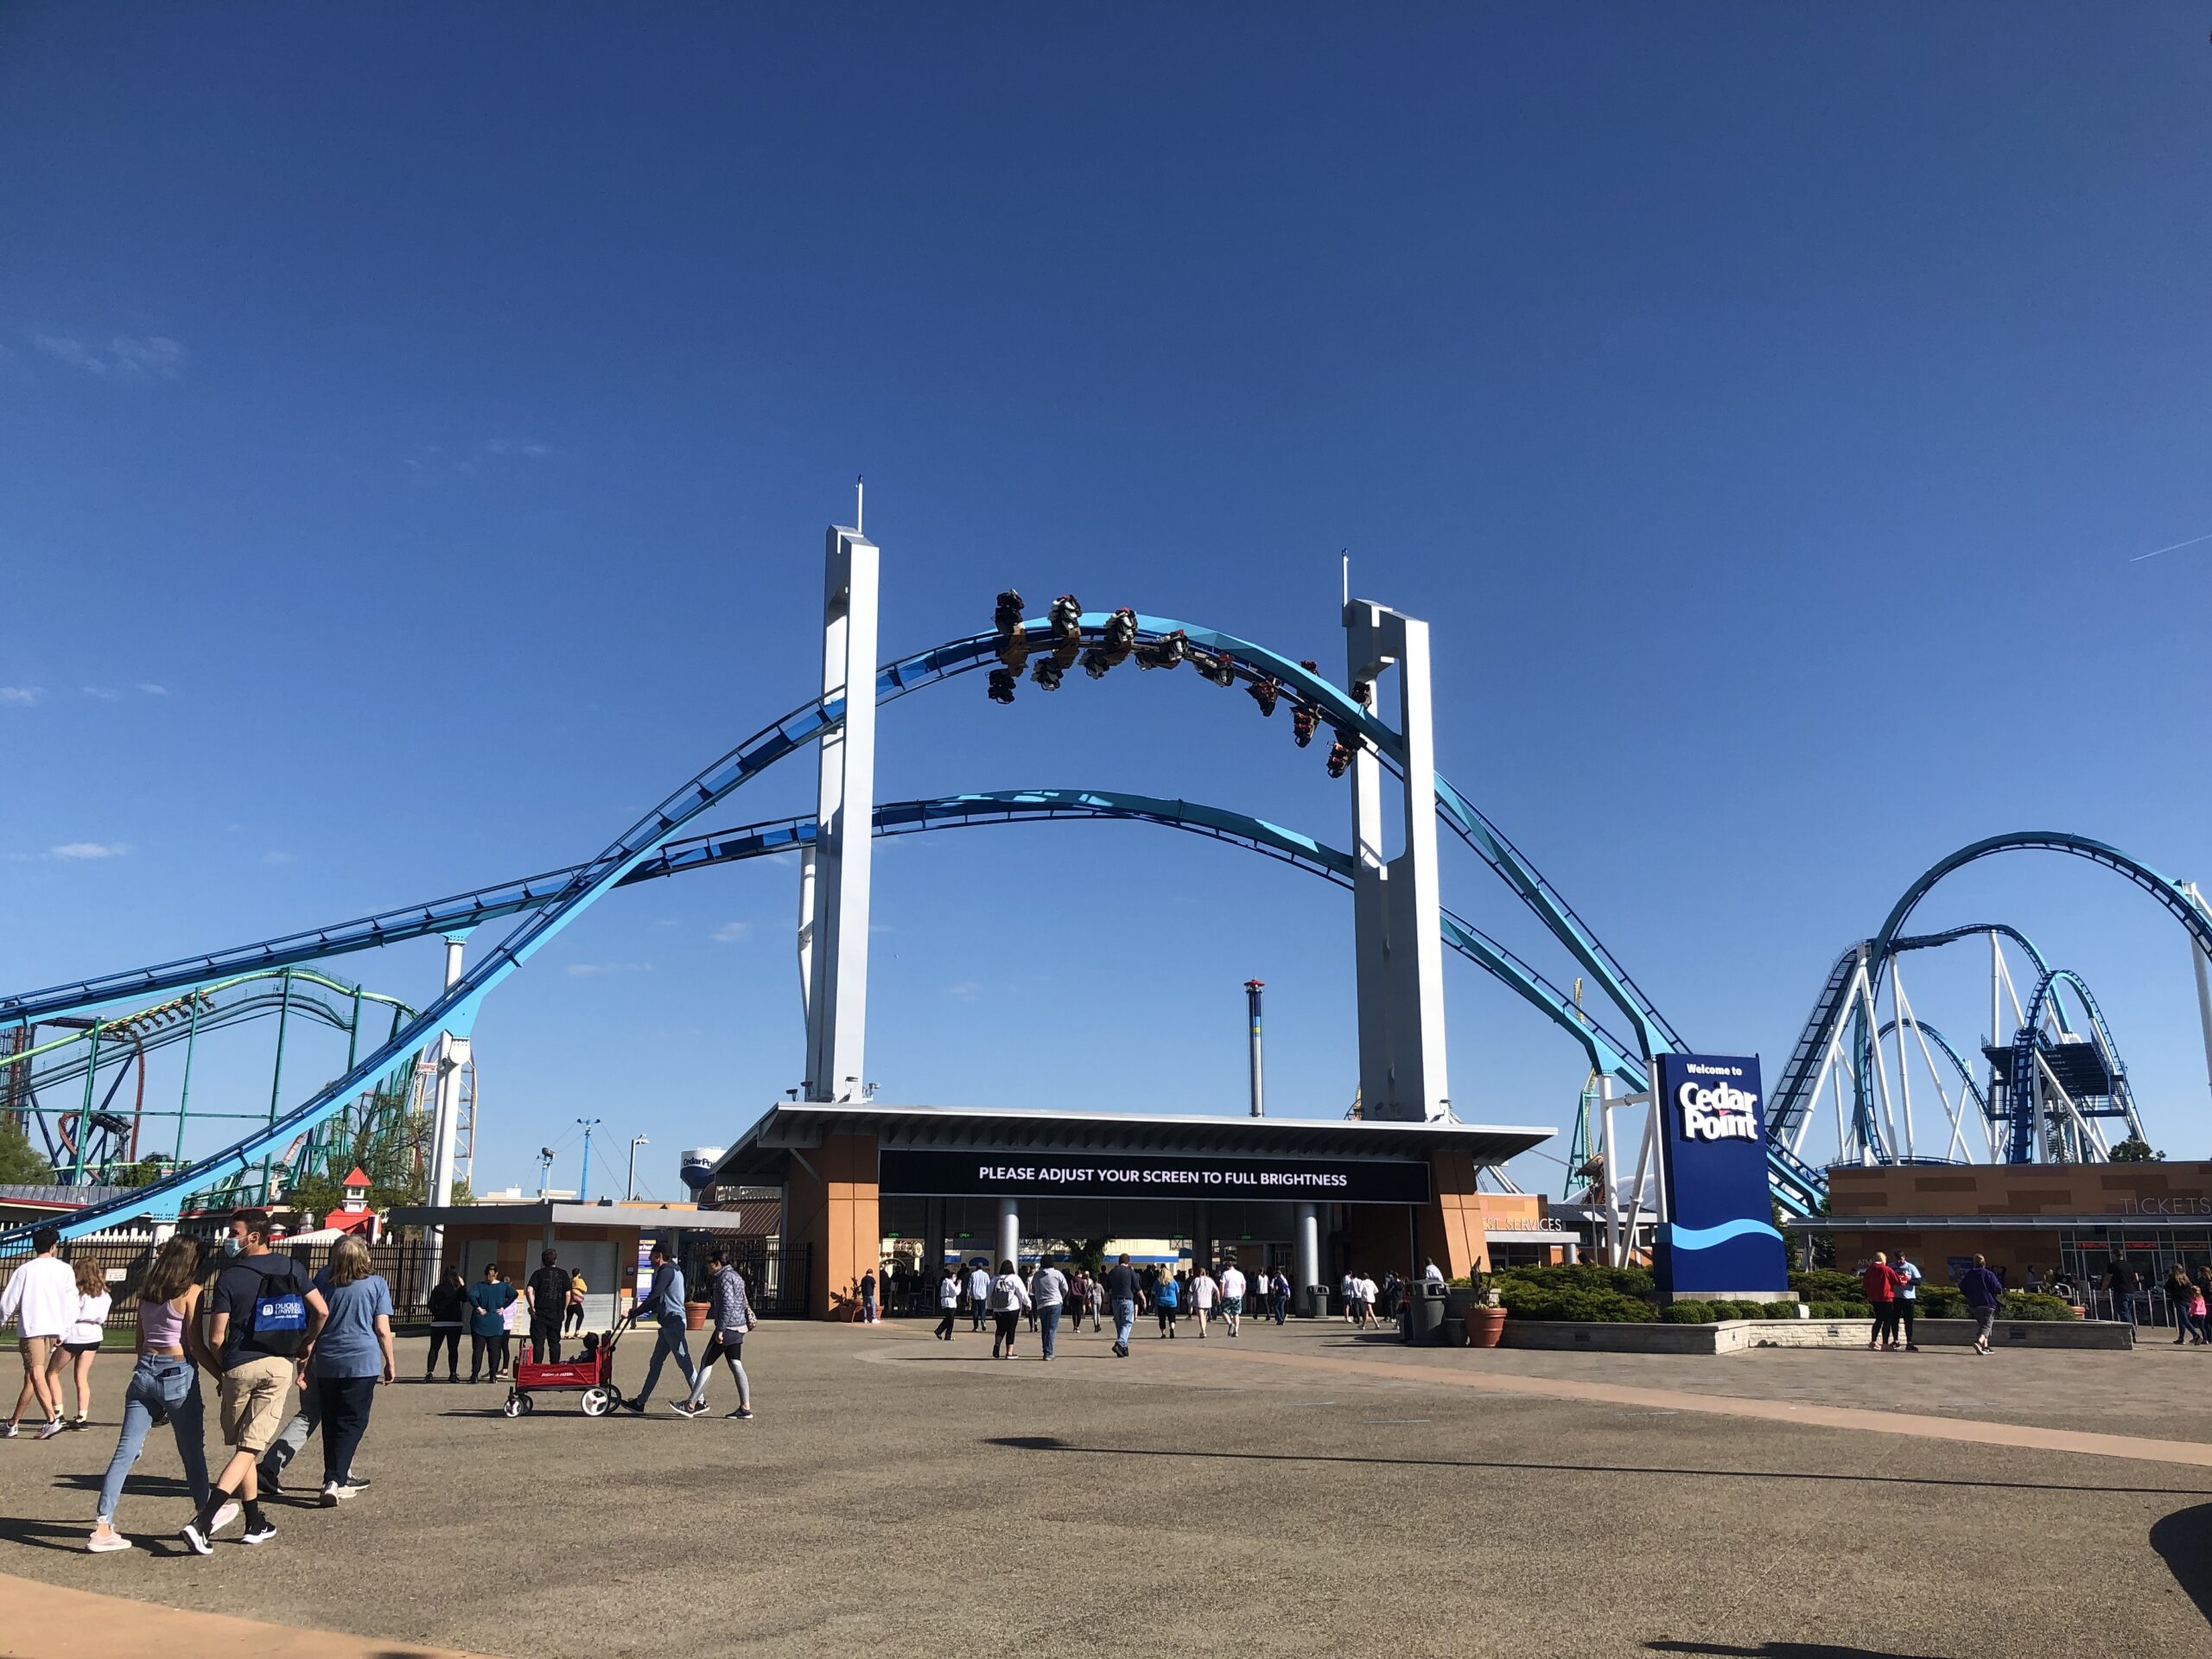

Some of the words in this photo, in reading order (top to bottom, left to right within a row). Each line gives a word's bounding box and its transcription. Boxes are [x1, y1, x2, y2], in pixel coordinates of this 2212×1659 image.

[1687, 1064, 1730, 1075] Welcome
[1732, 1066, 1743, 1076] to
[1679, 1082, 1758, 1114] Cedar
[1684, 1108, 1758, 1140] Point
[683, 1156, 702, 1166] Cedar
[979, 1166, 1035, 1180] PLEASE
[1038, 1168, 1095, 1184] ADJUST
[1097, 1169, 1140, 1182] YOUR
[1142, 1170, 1199, 1184] SCREEN
[1202, 1171, 1222, 1185] TO
[1224, 1172, 1257, 1185] FULL
[1260, 1173, 1348, 1186] BRIGHTNESS
[2120, 1197, 2212, 1215] TICKETS
[1506, 1217, 1562, 1231] SERVICES
